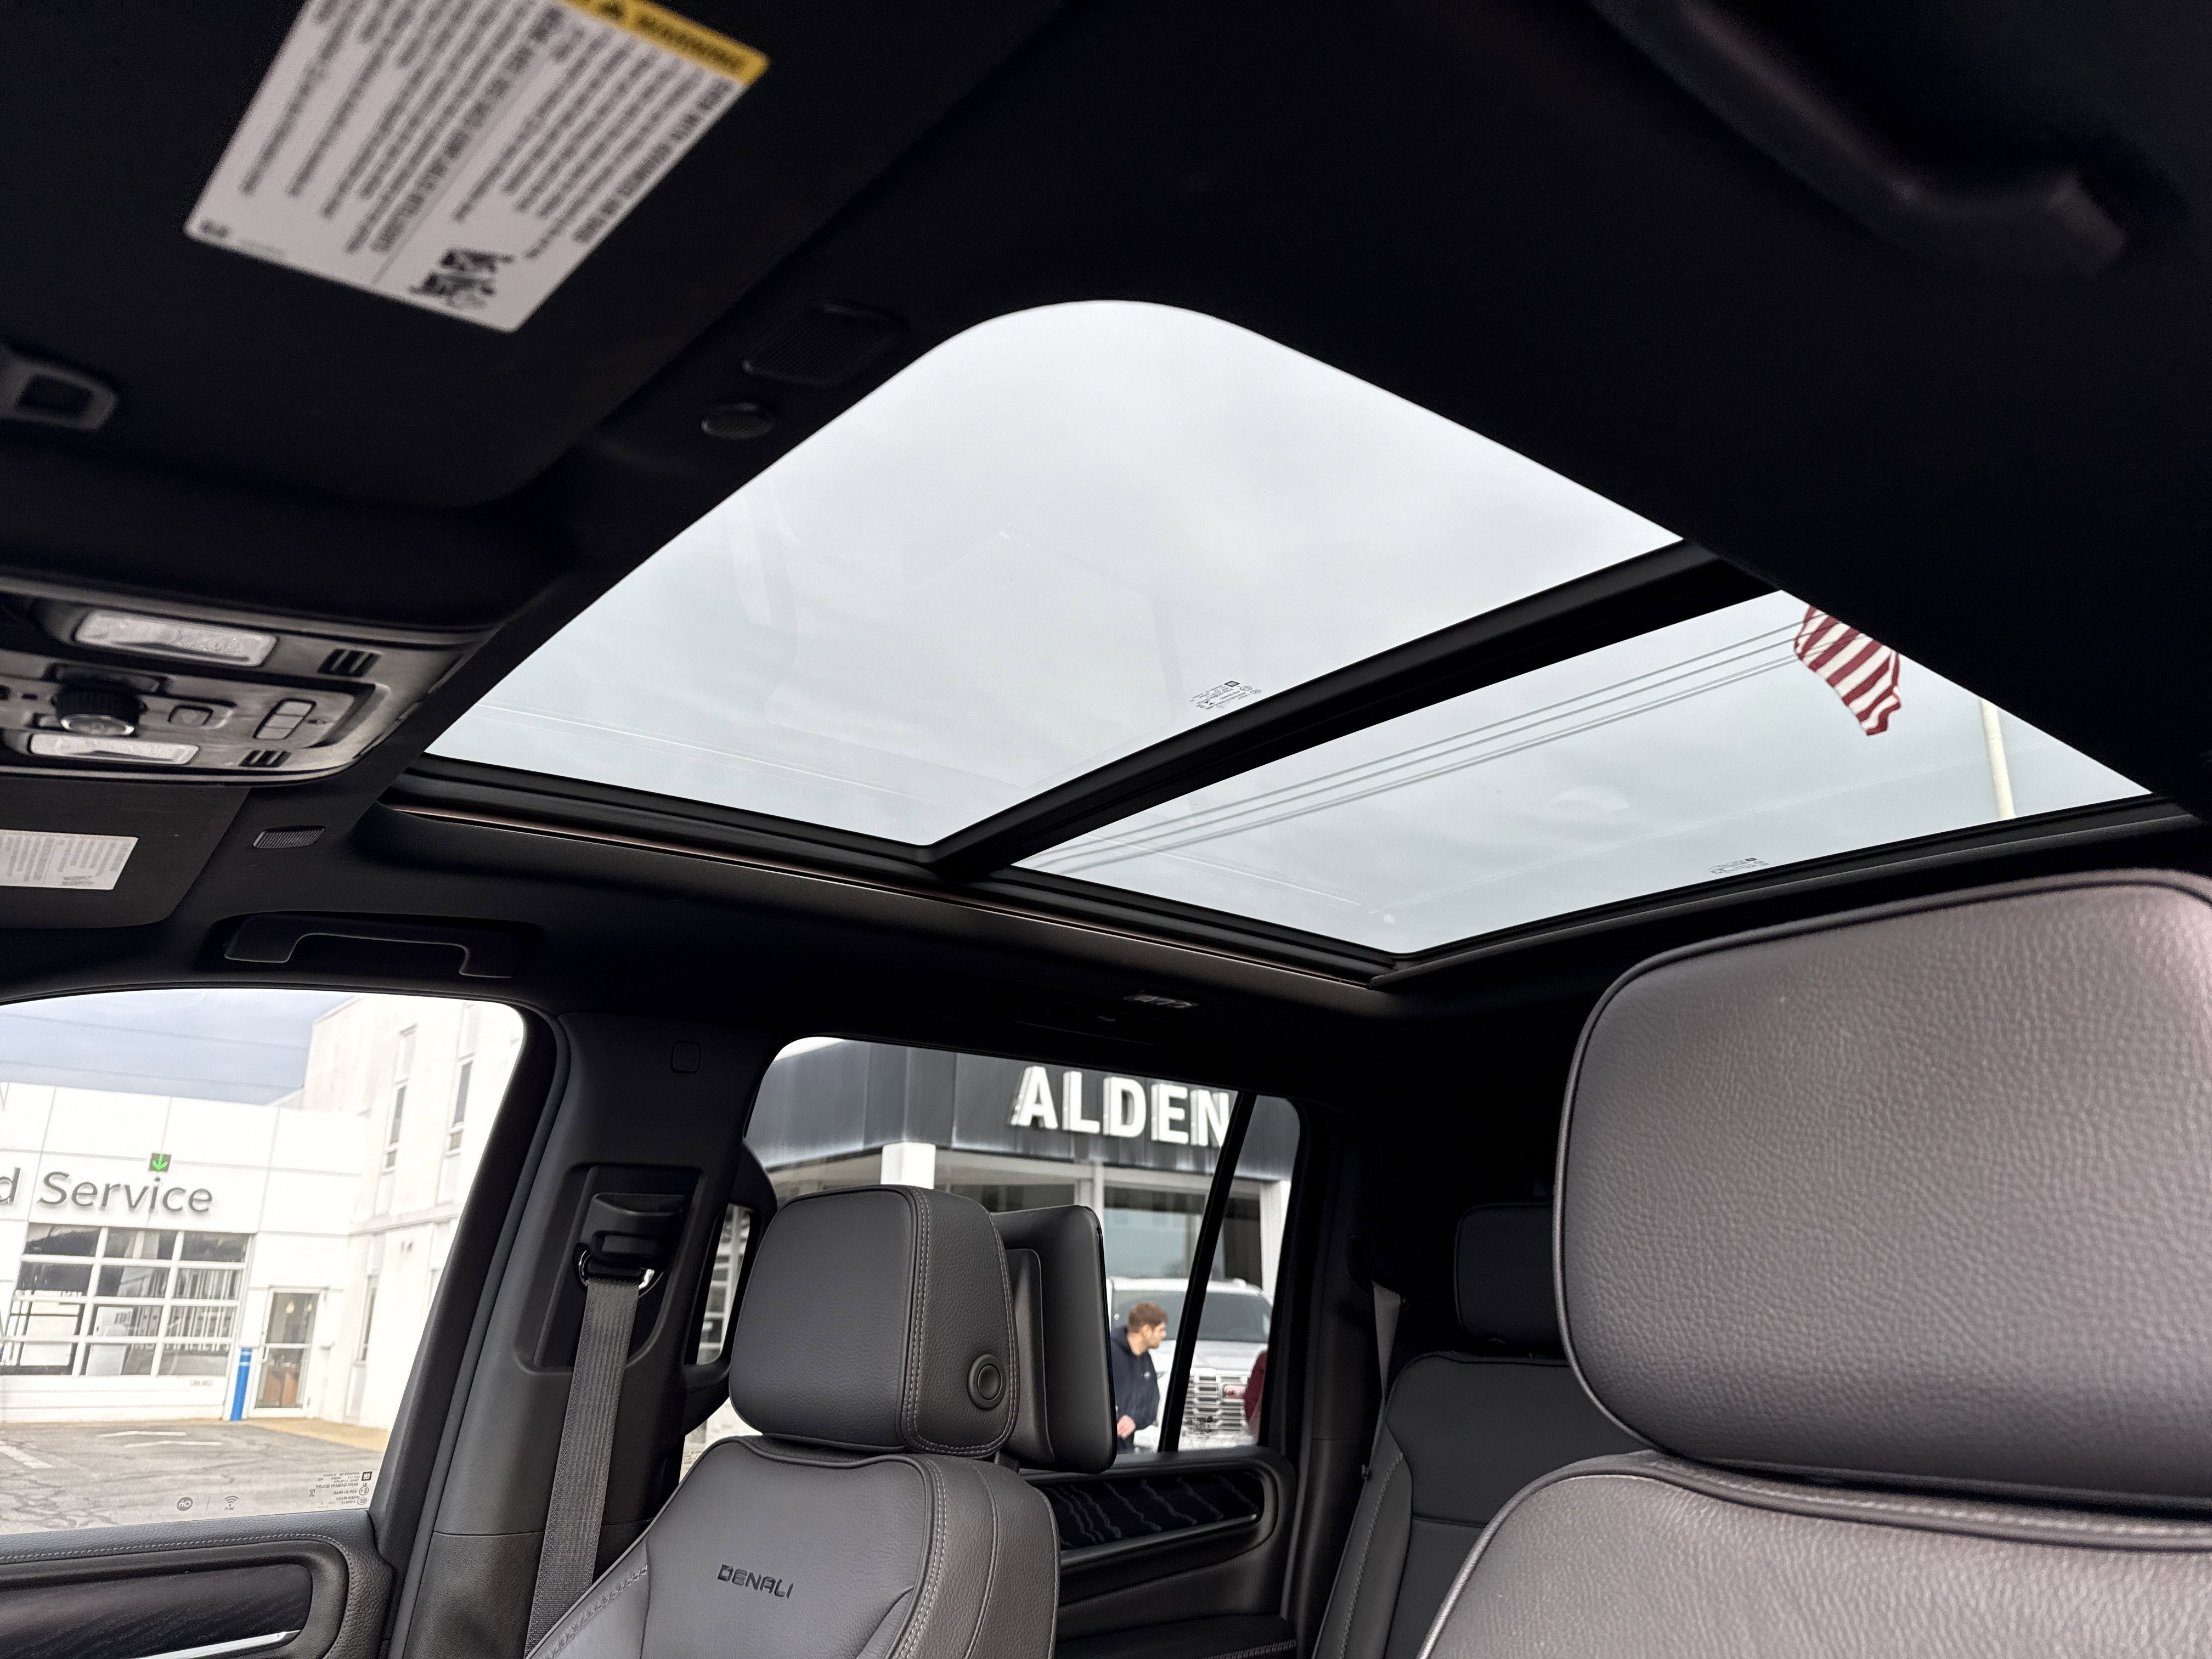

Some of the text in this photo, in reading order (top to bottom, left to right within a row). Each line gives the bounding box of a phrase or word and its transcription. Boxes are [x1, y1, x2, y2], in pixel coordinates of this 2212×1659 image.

[1010, 1065, 1230, 1148] ALDEN
[37, 1171, 213, 1213] Service
[717, 1564, 794, 1599] DENALI
